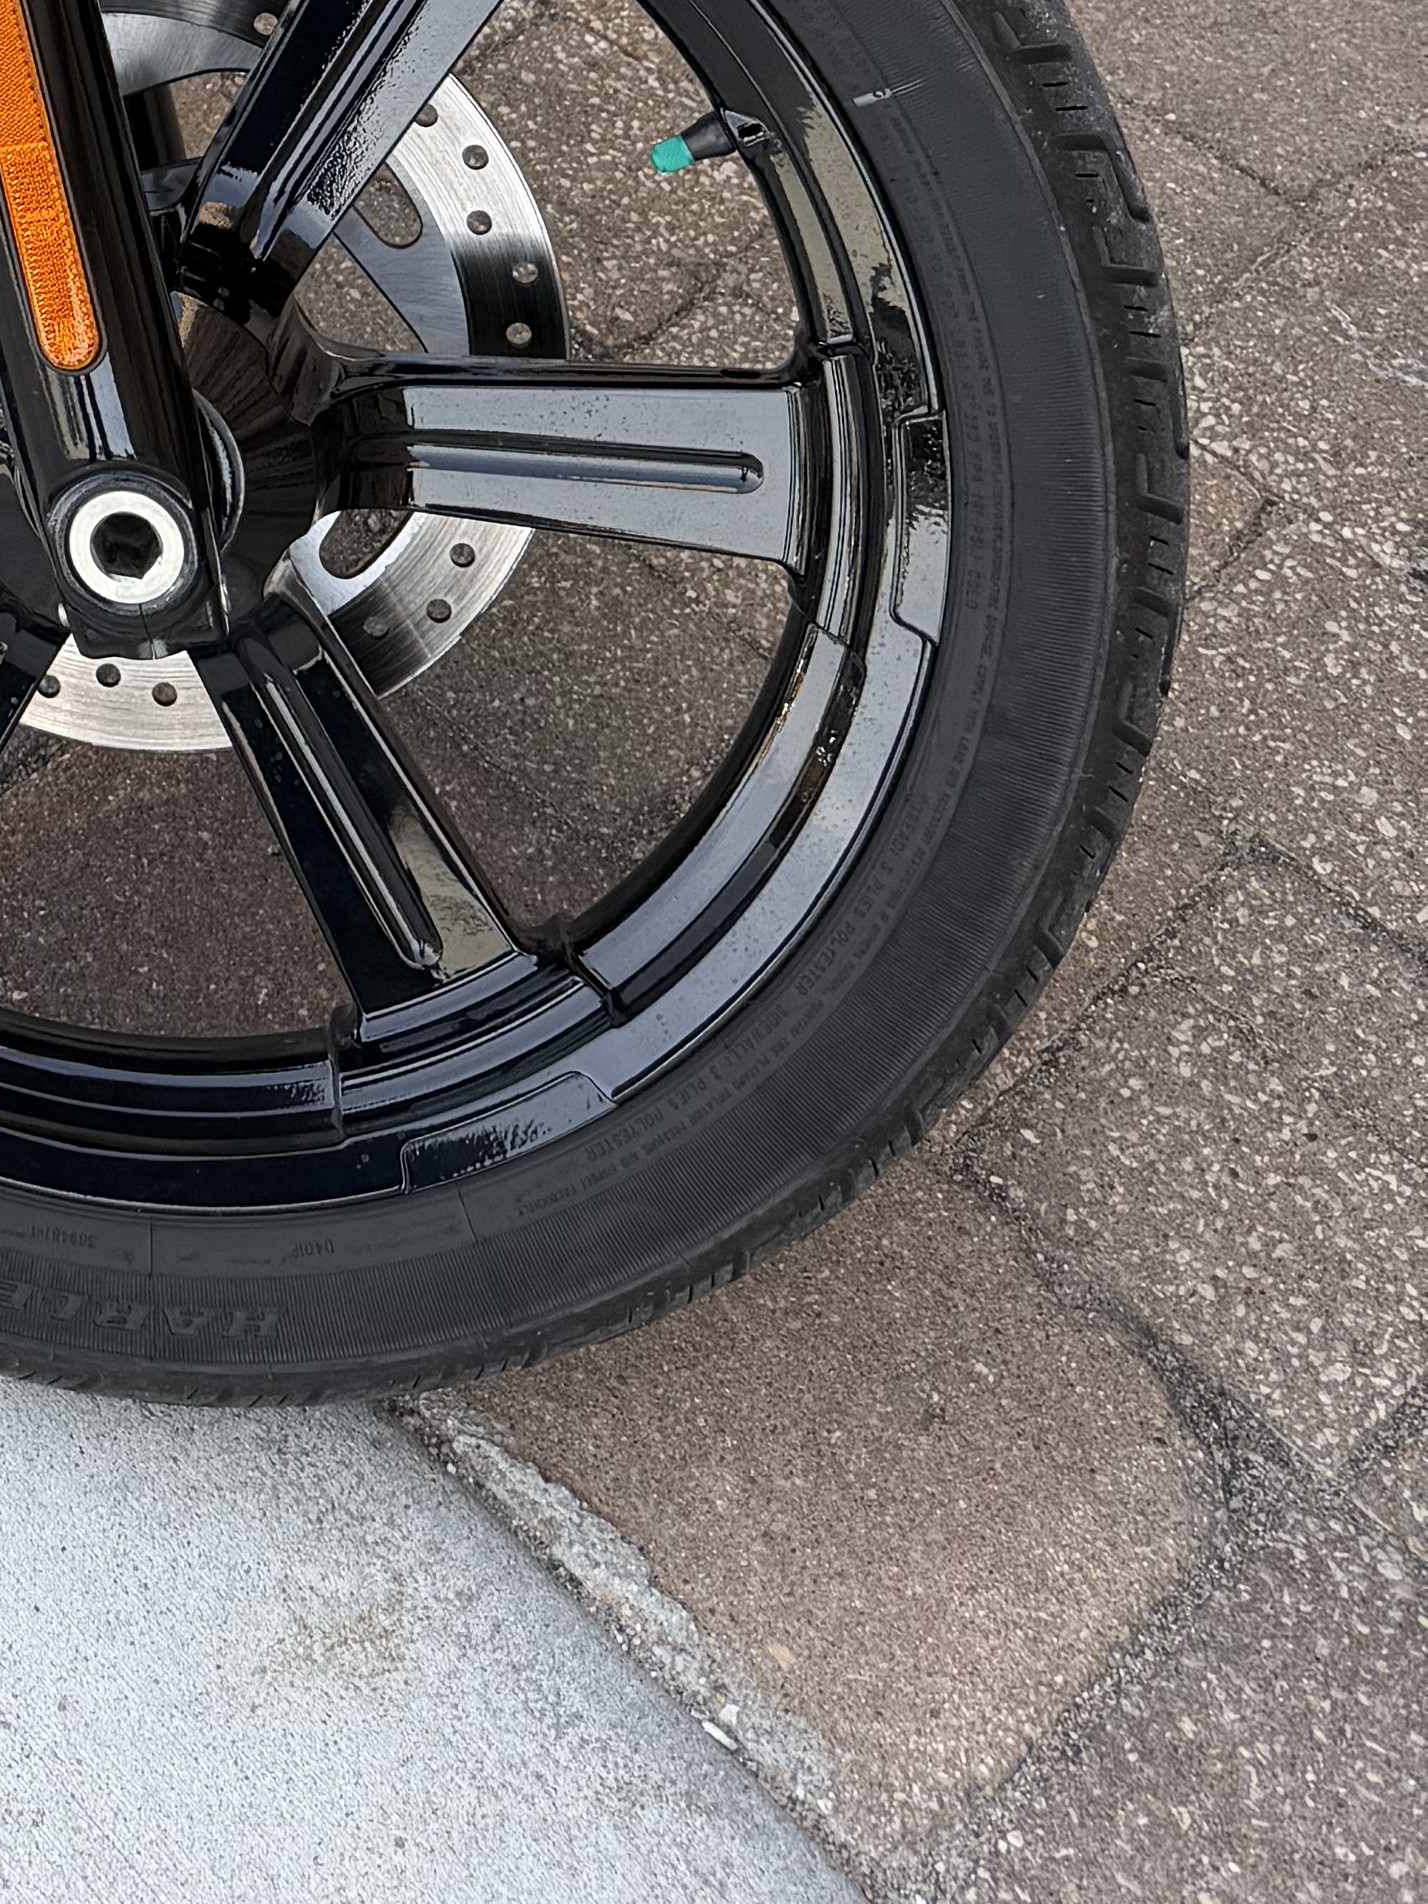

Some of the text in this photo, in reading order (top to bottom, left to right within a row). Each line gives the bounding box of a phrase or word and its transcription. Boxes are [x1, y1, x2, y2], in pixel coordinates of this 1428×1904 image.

[849, 873, 887, 922] PLIES
[790, 918, 858, 999] POLYESTER
[664, 1074, 710, 1114] PLIES
[580, 1105, 667, 1165] POLYESTER
